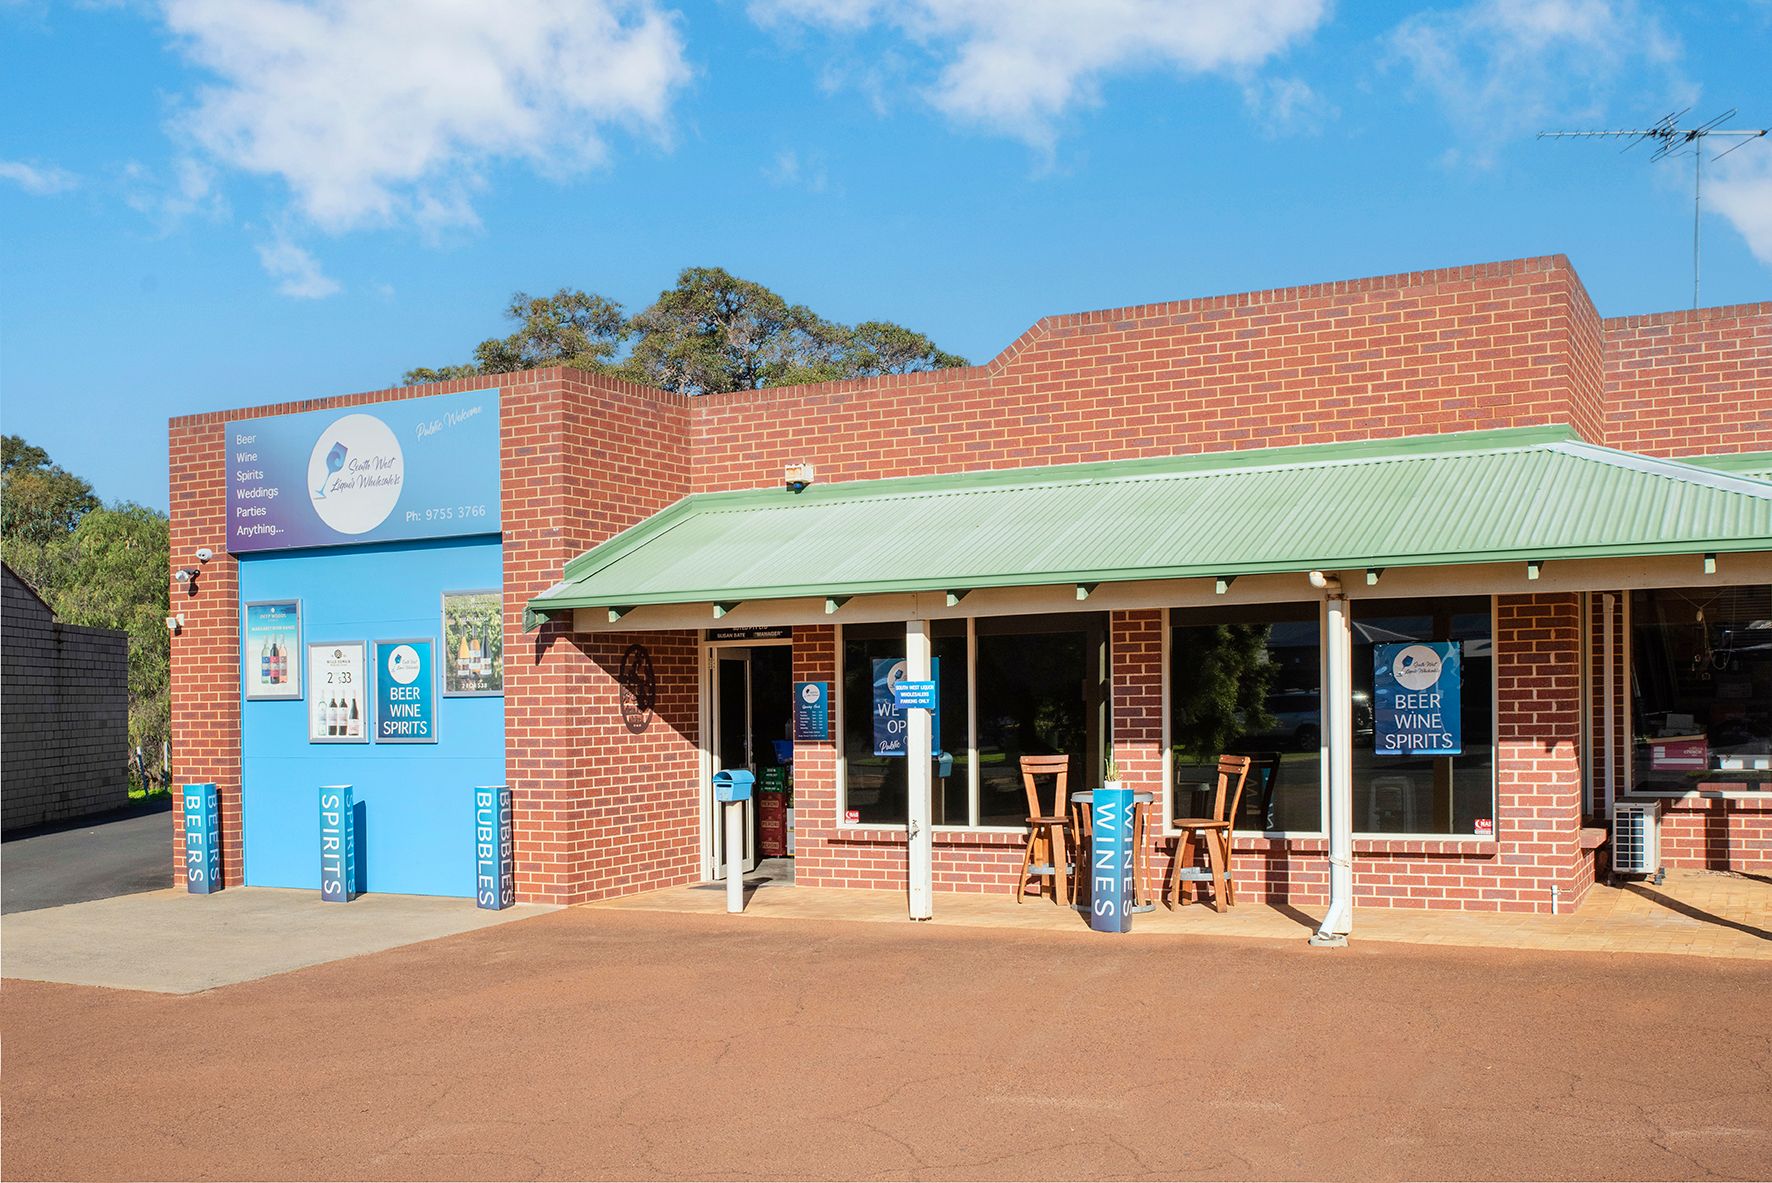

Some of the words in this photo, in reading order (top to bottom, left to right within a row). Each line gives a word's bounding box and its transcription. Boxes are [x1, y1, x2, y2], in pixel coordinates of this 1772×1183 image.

[416, 420, 443, 441] Public
[443, 405, 483, 428] Welcome
[236, 434, 256, 445] Beer
[236, 452, 258, 463] Wine
[348, 457, 371, 475] South
[372, 455, 396, 470] West
[236, 470, 264, 483] Spirits
[236, 486, 279, 500] Weddings
[236, 506, 267, 518] Parties
[406, 510, 421, 522] Ph:
[425, 507, 453, 520] 9755
[457, 504, 486, 518] 3766
[236, 523, 284, 538] Anything...
[328, 672, 332, 684] 2
[390, 687, 420, 701] BEER
[1395, 694, 1441, 709] BEER
[390, 704, 421, 718] WINE
[384, 721, 428, 735] SPIRITS
[1394, 714, 1442, 729] WINE
[880, 740, 901, 754] Public
[1385, 733, 1454, 749] SPIRITS
[186, 796, 204, 882] BEERS
[208, 795, 220, 881] BEERS
[322, 794, 341, 894] SPIRITS
[477, 792, 494, 905] BUBBLES
[500, 792, 513, 905] BUBBLES
[1094, 802, 1116, 916] WINES
[1123, 803, 1134, 917] WINES
